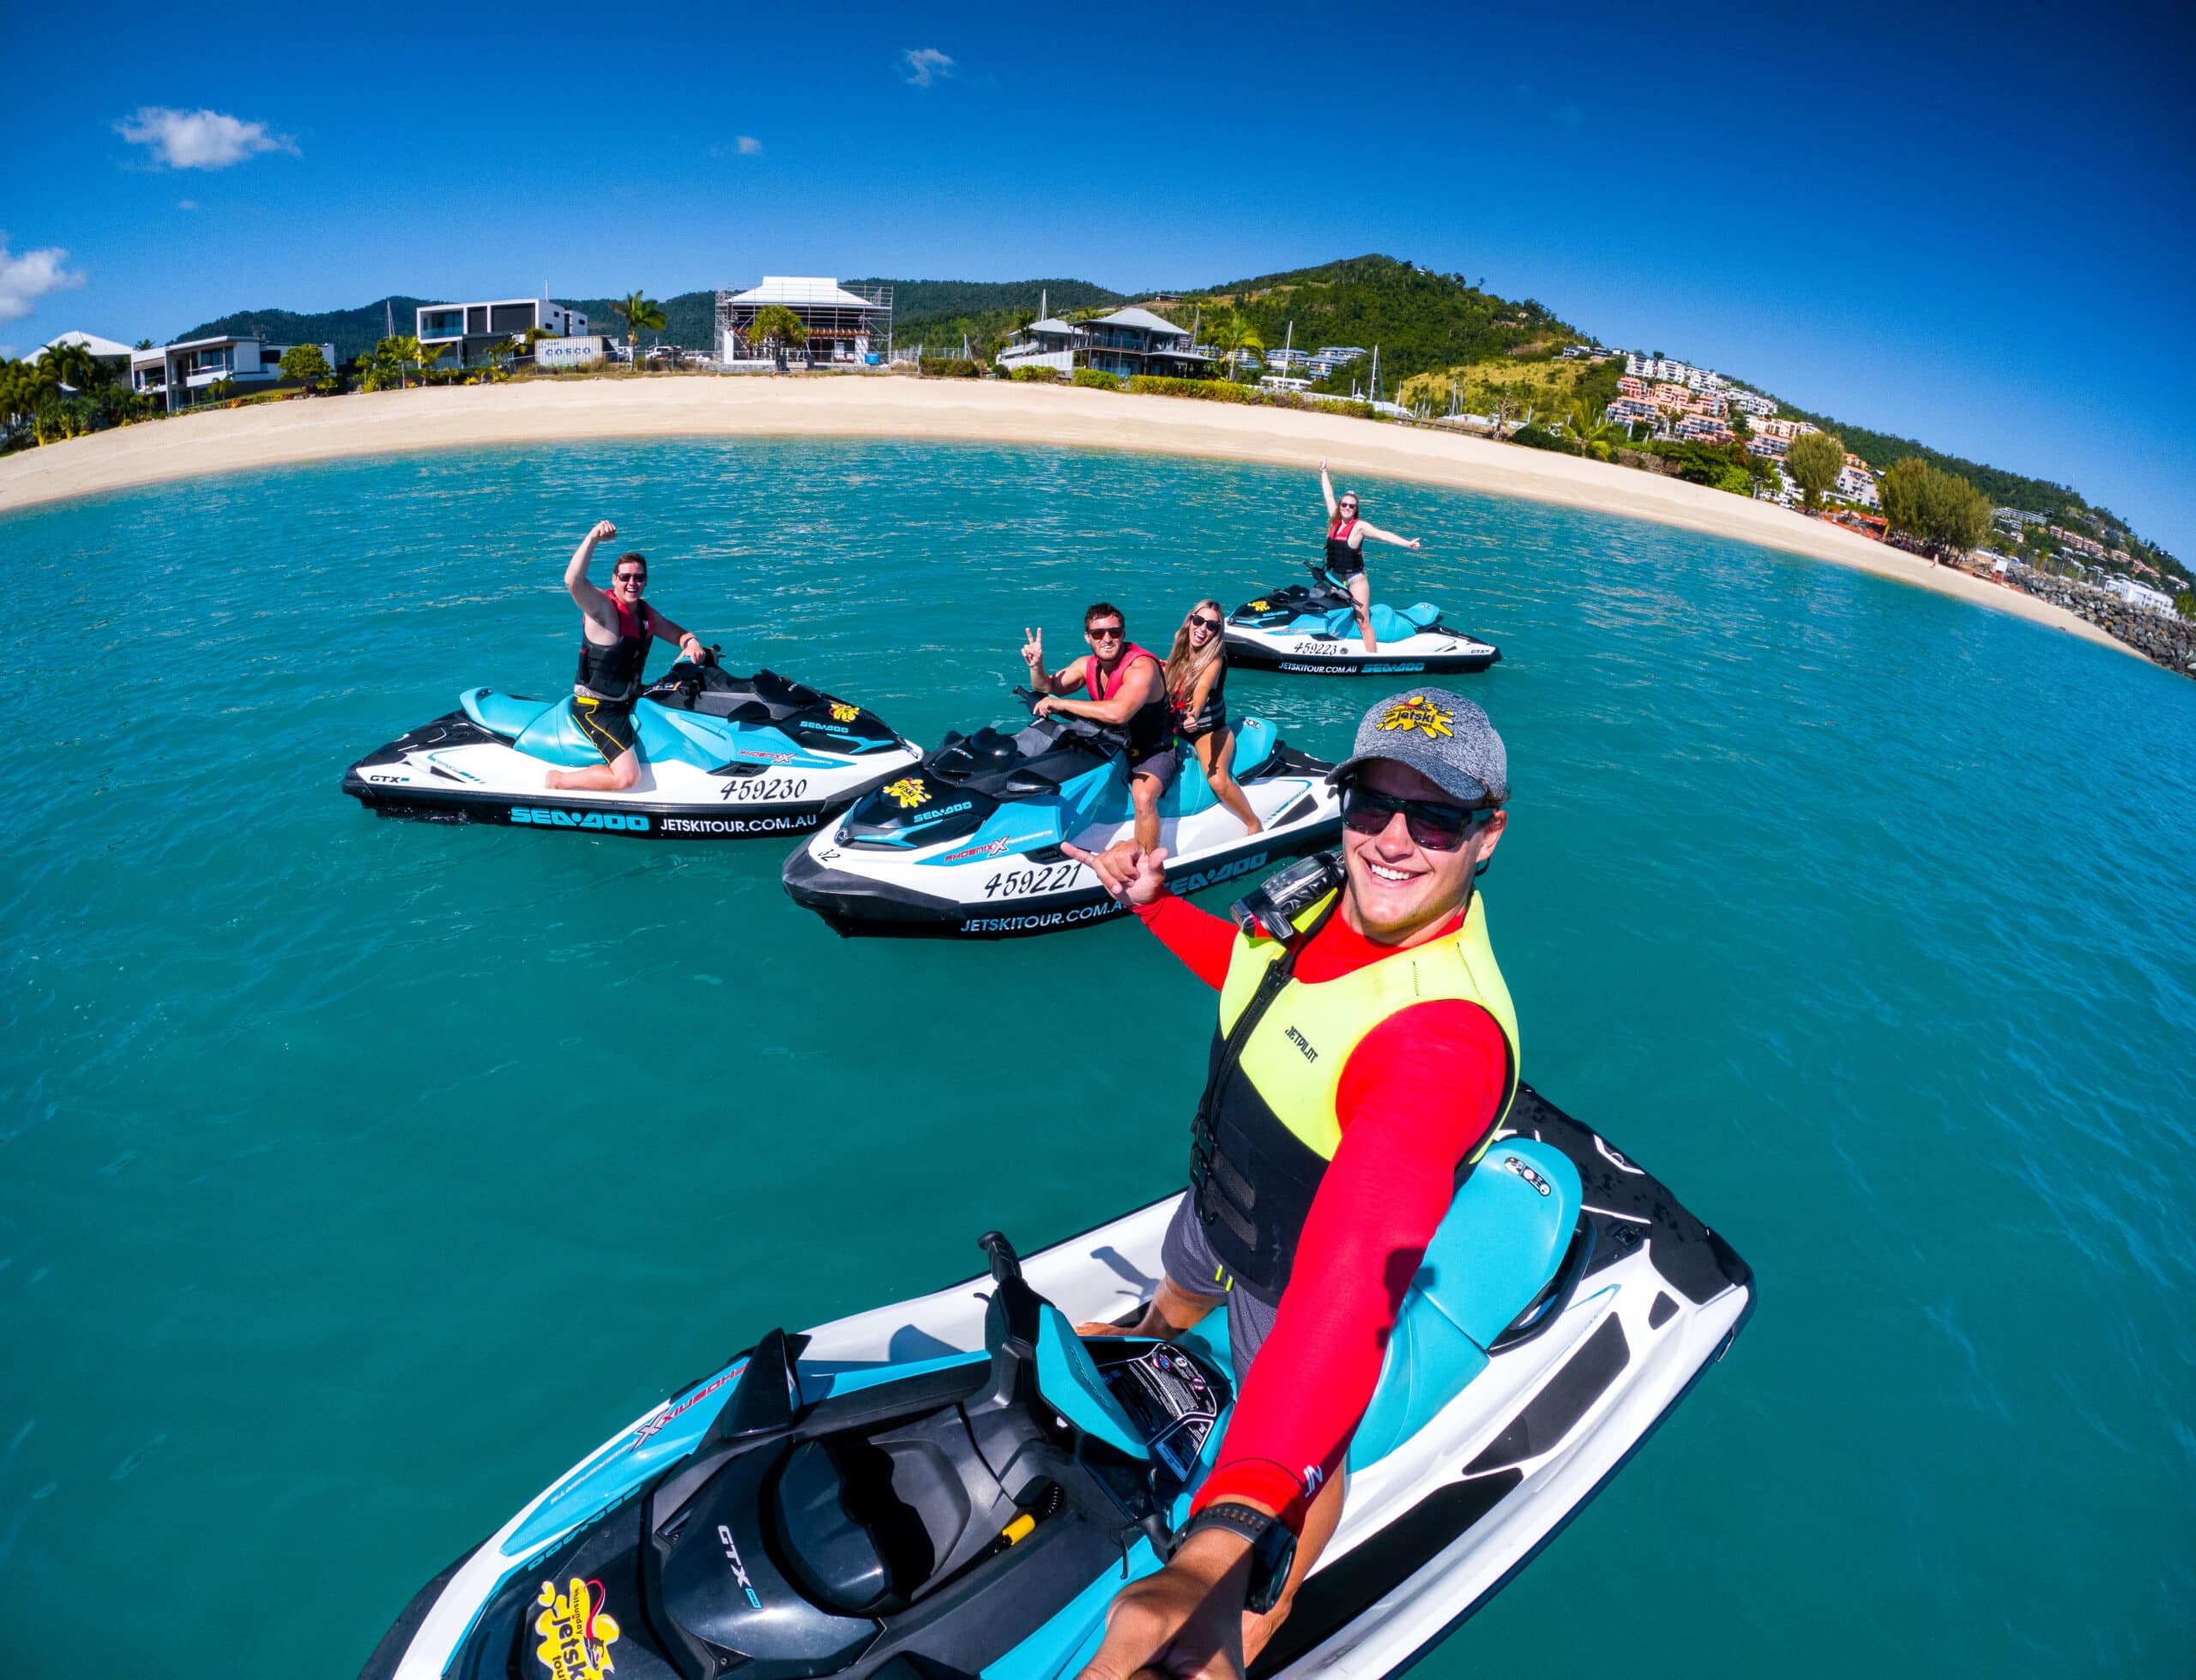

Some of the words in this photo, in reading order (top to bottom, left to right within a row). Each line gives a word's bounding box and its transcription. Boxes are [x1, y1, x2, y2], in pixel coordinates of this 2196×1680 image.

[546, 347, 591, 356] COSCO
[1294, 642, 1337, 655] 459223
[1278, 662, 1357, 673] JETSKITOUR.COM.AU
[721, 778, 807, 801] 459230
[661, 814, 817, 833] JETSKITOUR.COM.AU
[985, 863, 1083, 898] 459221
[960, 900, 1129, 932] JETSKITOUR.COM.A
[1284, 1025, 1318, 1063] JETPILOT
[718, 1526, 751, 1588] GTX
